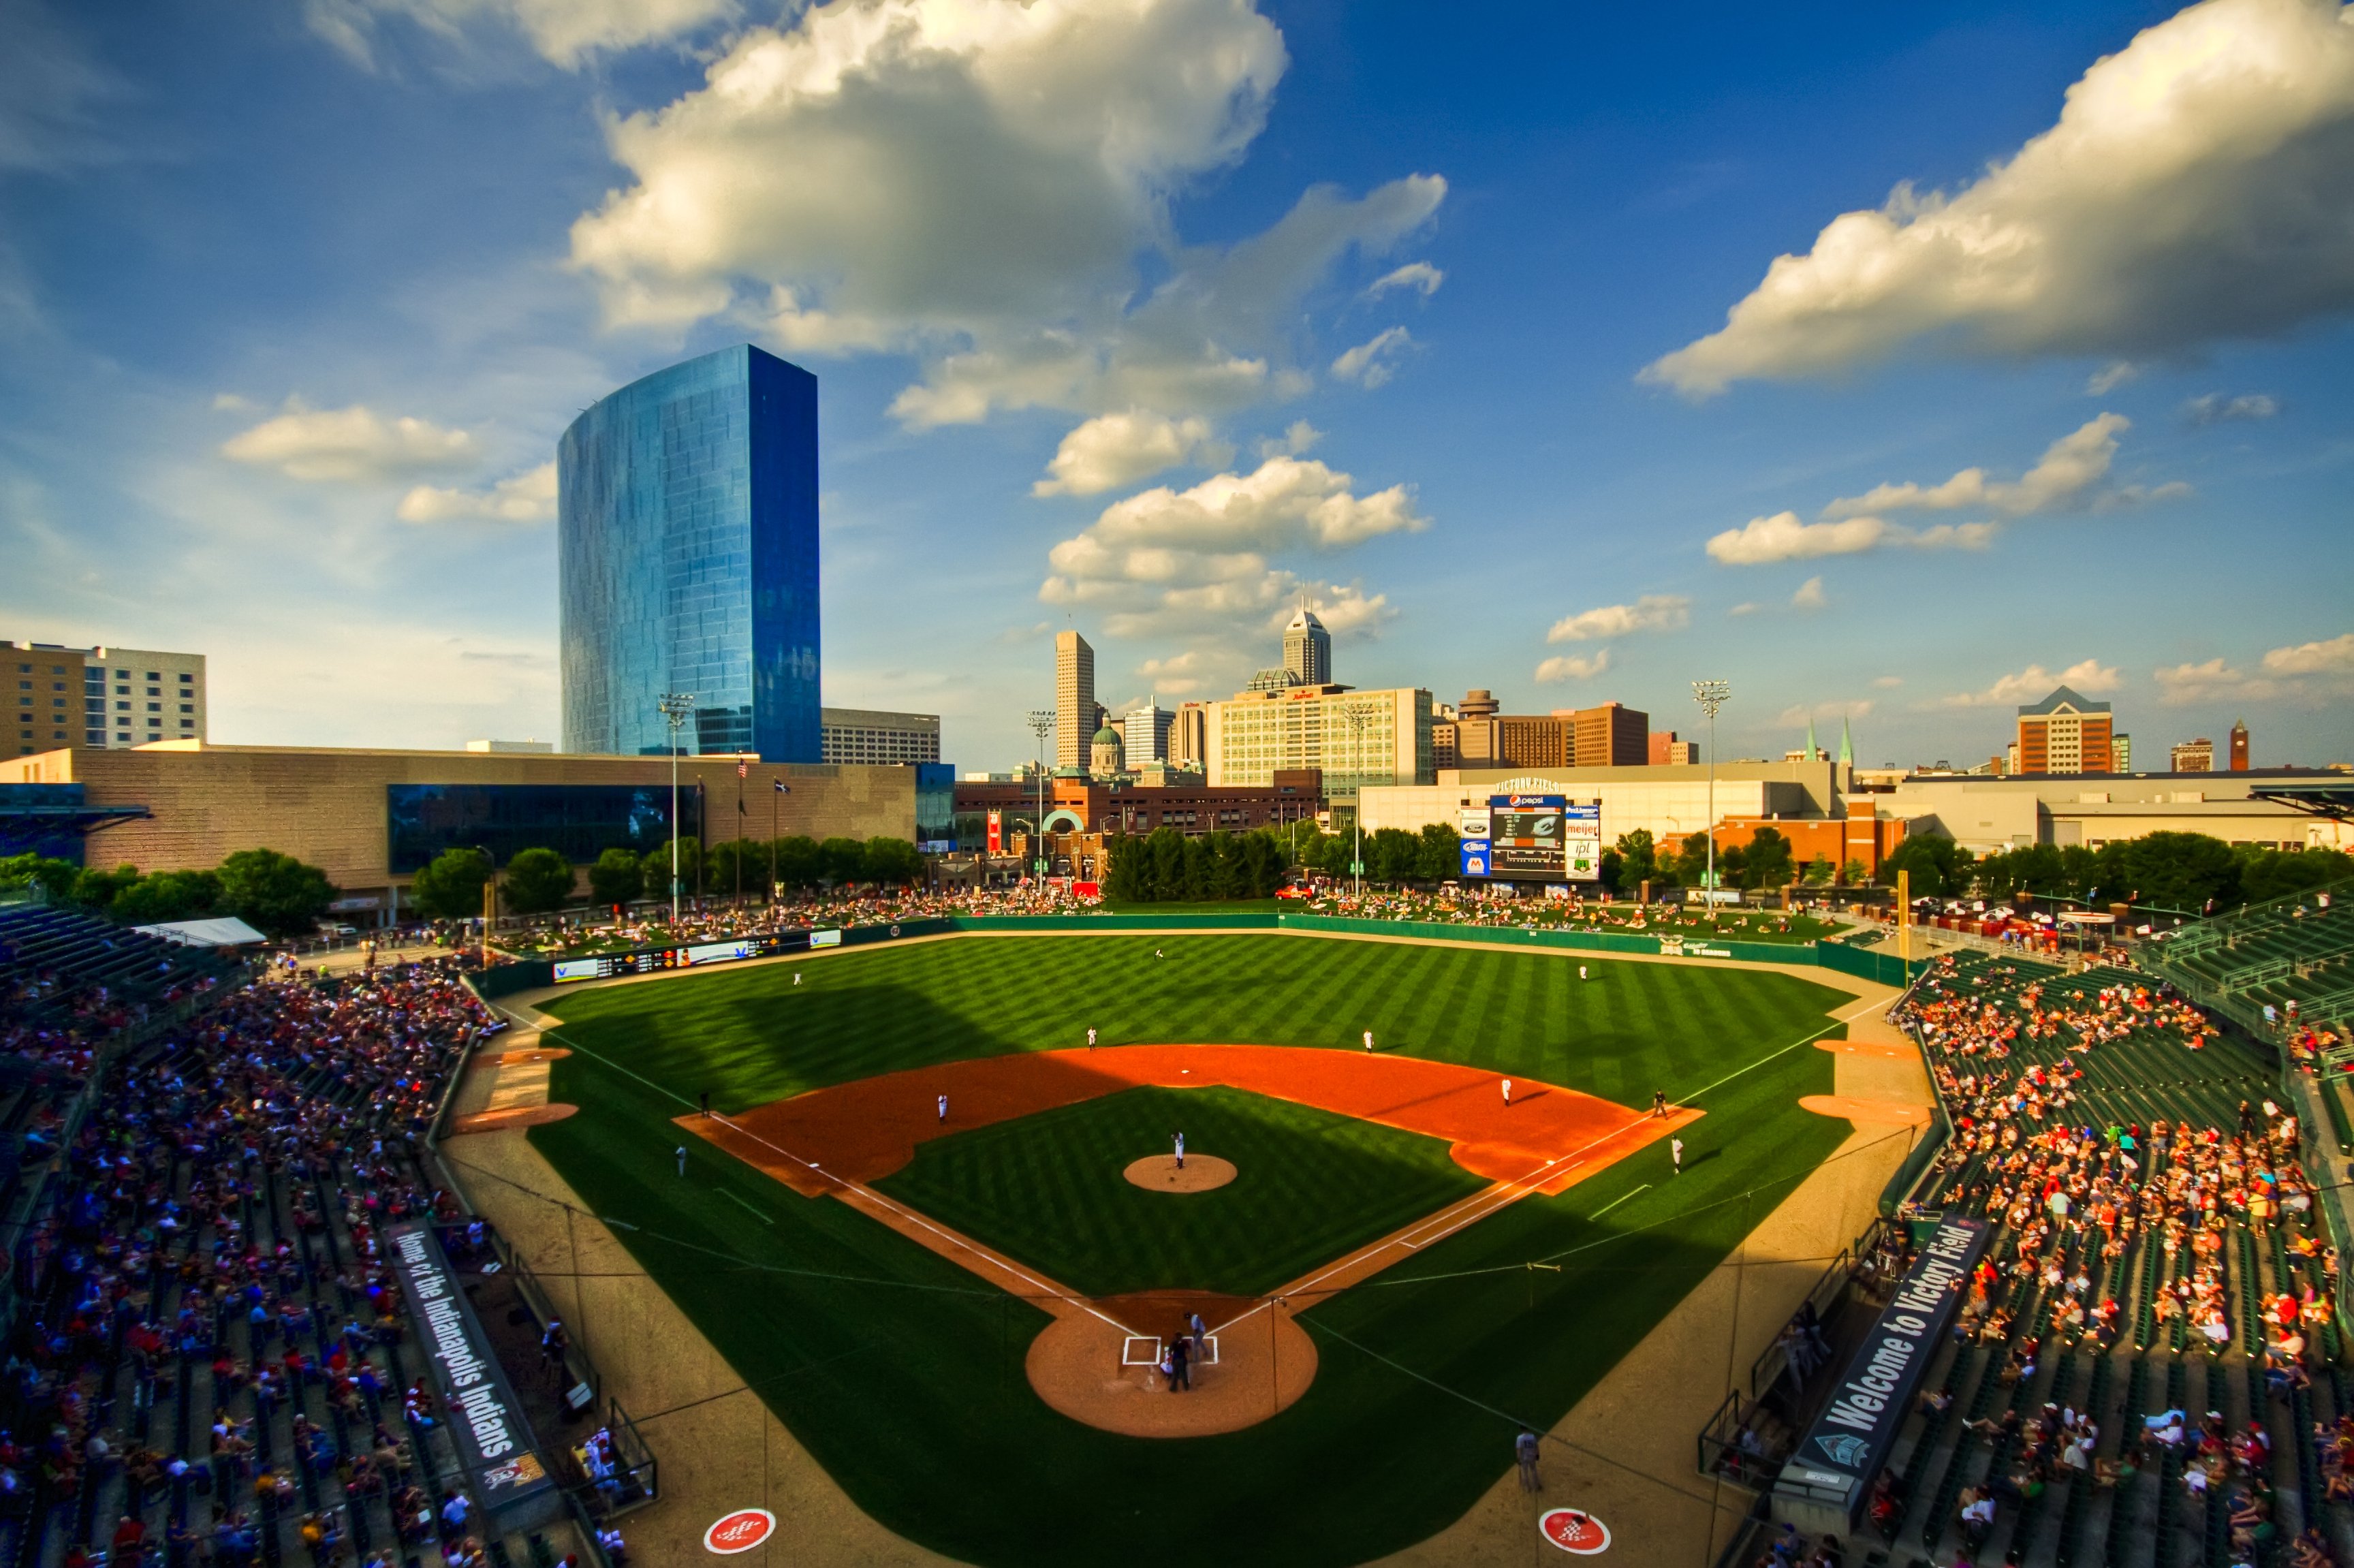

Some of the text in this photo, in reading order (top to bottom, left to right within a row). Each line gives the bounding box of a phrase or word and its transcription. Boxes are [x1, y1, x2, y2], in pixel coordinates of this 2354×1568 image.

[1495, 777, 1560, 794] VICTORY FIELD
[1521, 796, 1543, 806] pepsi
[1567, 822, 1597, 835] meijer
[1575, 841, 1590, 858] ipl
[1825, 1224, 1975, 1431] Welcome to Victory Field
[396, 1231, 514, 1458] Home of the Indianapolis Indians
